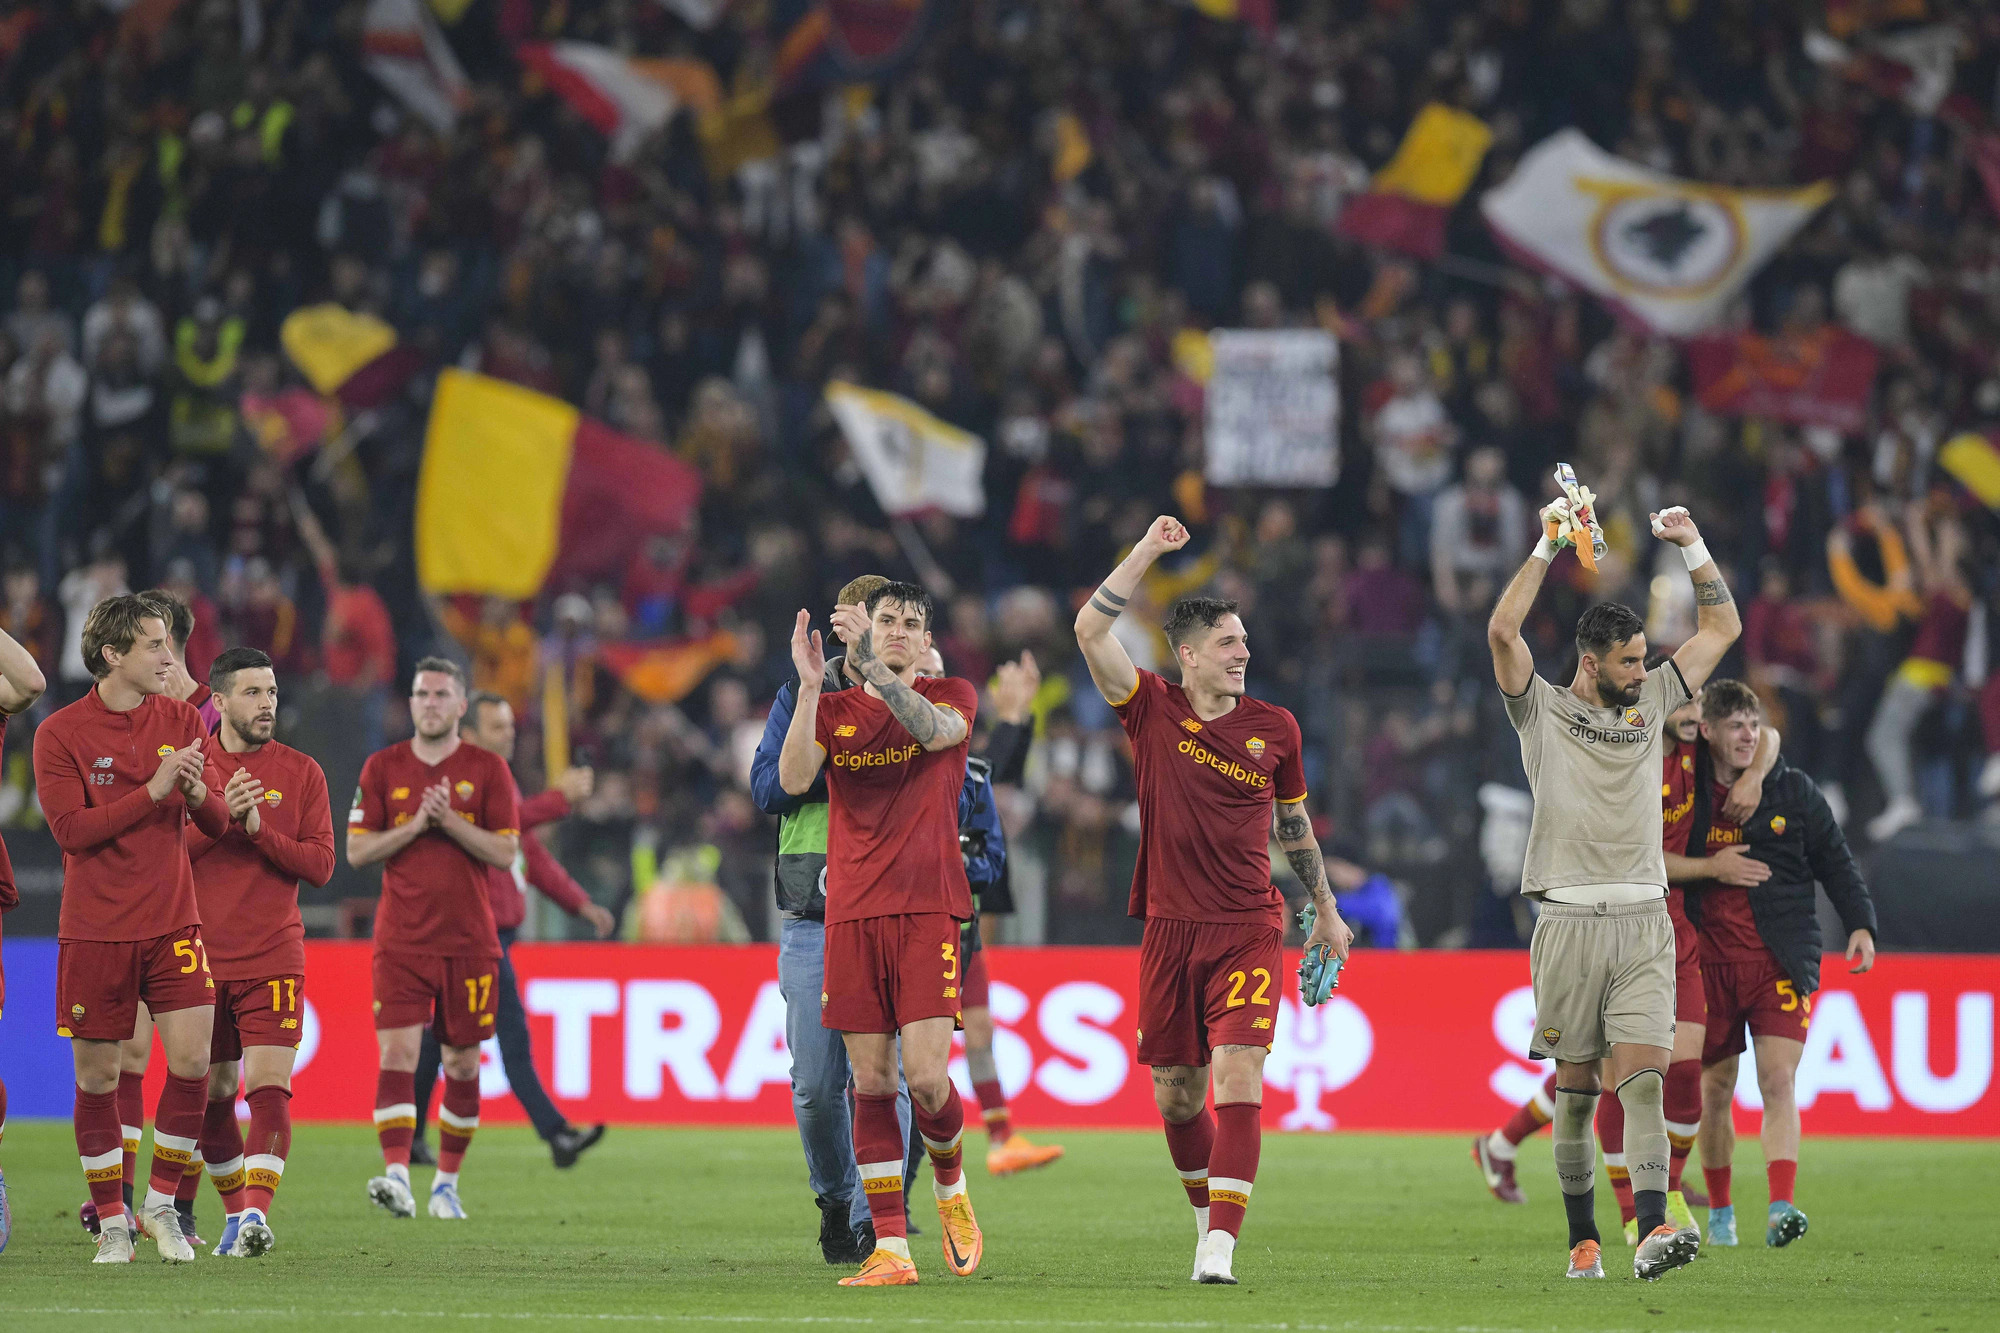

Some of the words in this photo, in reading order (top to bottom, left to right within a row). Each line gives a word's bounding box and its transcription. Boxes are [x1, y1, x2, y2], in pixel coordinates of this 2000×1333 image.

[1569, 725, 1649, 744] digitalbits
[833, 743, 921, 772] digitalbits
[1177, 738, 1268, 788] digitalbits
[89, 773, 115, 785] #52
[941, 942, 957, 980] 3
[267, 978, 296, 1012] 11
[464, 973, 493, 1013] 17
[1226, 967, 1271, 1008] 22
